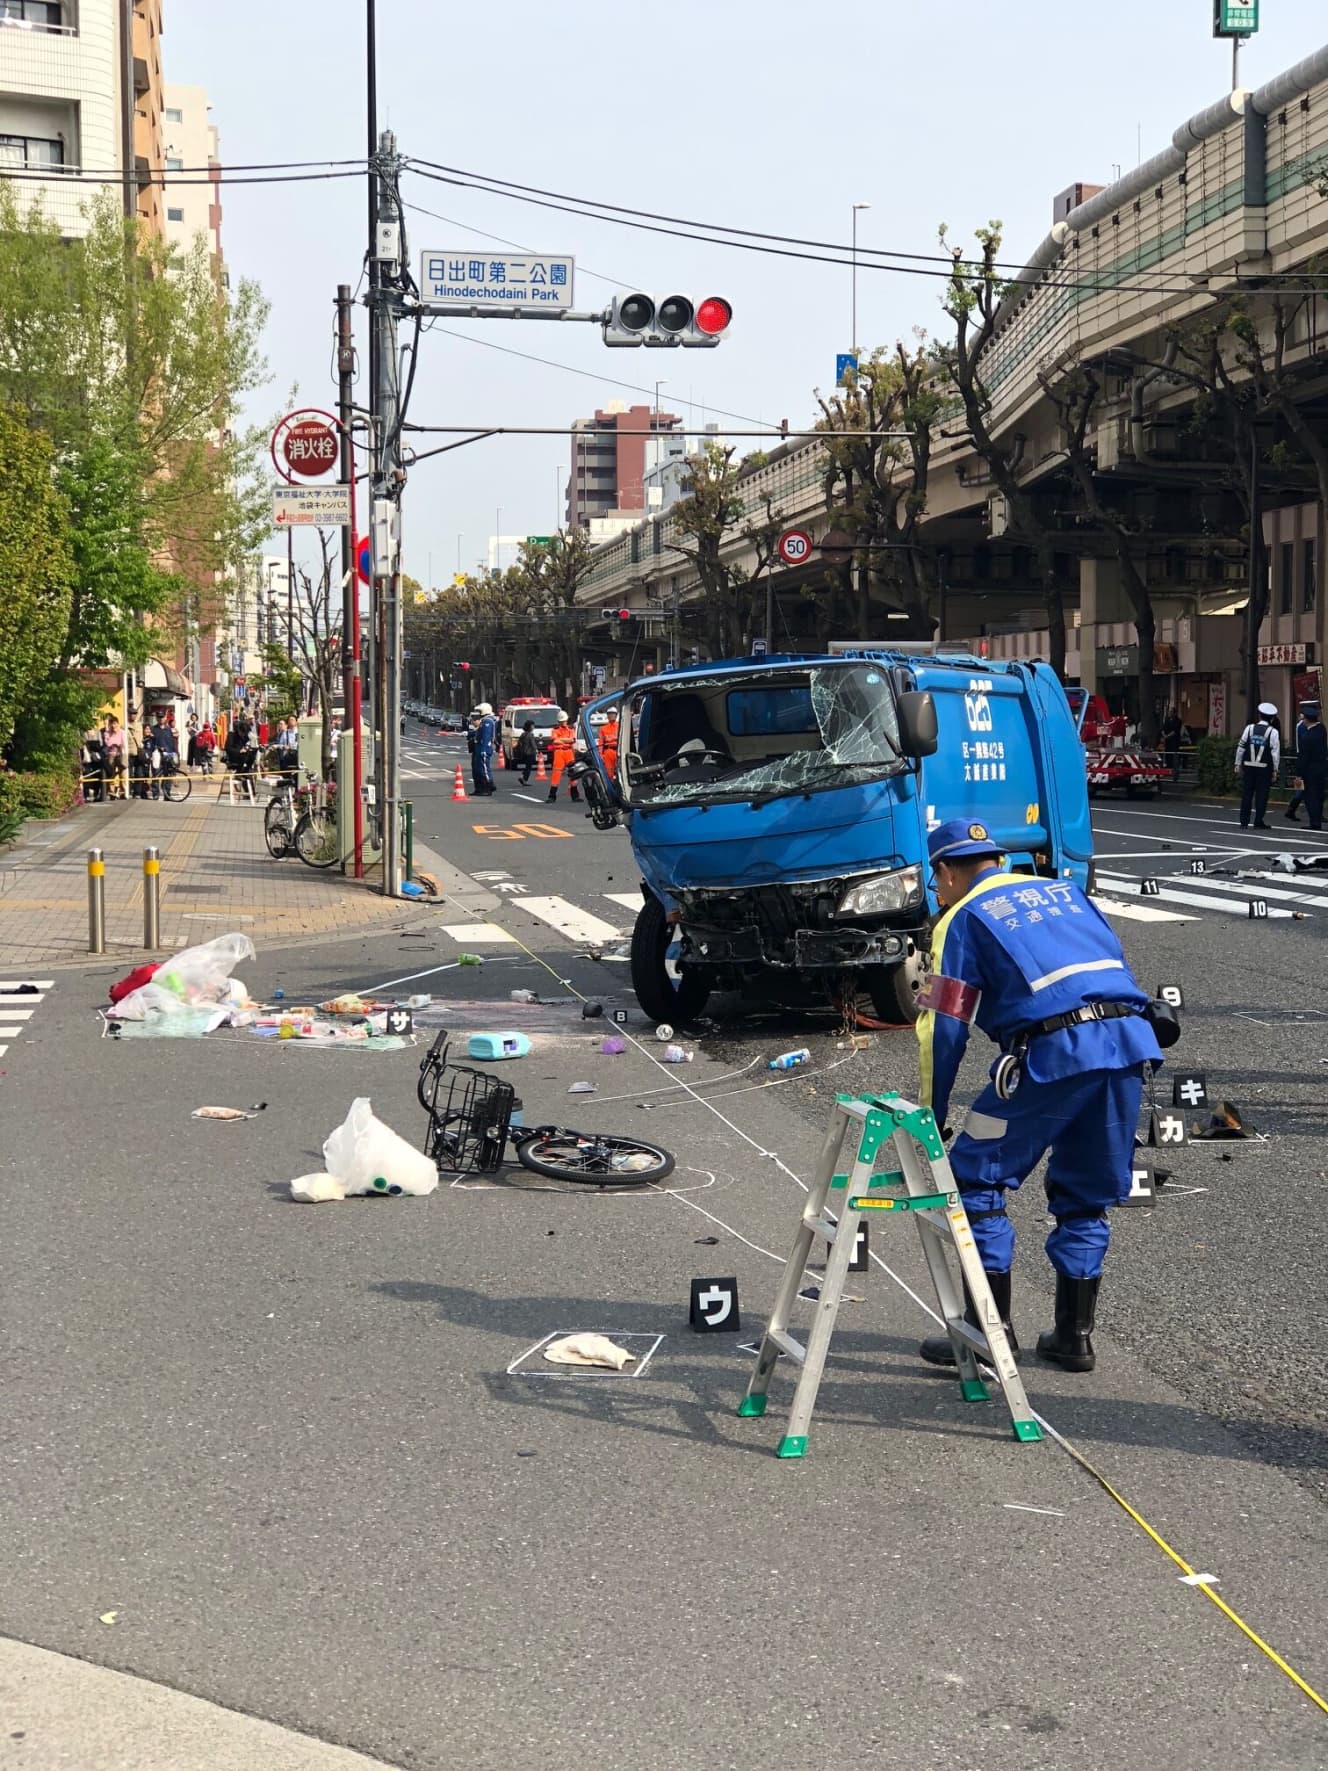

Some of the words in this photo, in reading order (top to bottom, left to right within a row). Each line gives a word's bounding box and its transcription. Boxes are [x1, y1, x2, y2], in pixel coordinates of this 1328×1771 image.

[429, 259, 567, 285] 日出町第二公園
[434, 284, 527, 299] Hinodechodaini
[531, 288, 559, 301] Park
[288, 437, 335, 460] 消火栓
[787, 540, 805, 554] 50
[472, 824, 575, 839] 50
[1191, 861, 1205, 873] 13
[1143, 881, 1159, 893] 11
[980, 883, 1072, 920] 警視庁
[1252, 901, 1267, 917] 10
[1162, 986, 1181, 1007] 9
[390, 1011, 410, 1032] サ
[617, 1012, 625, 1021] B
[1180, 1079, 1205, 1105] キ
[1159, 1115, 1184, 1142] カ
[698, 1285, 732, 1326] ウ
